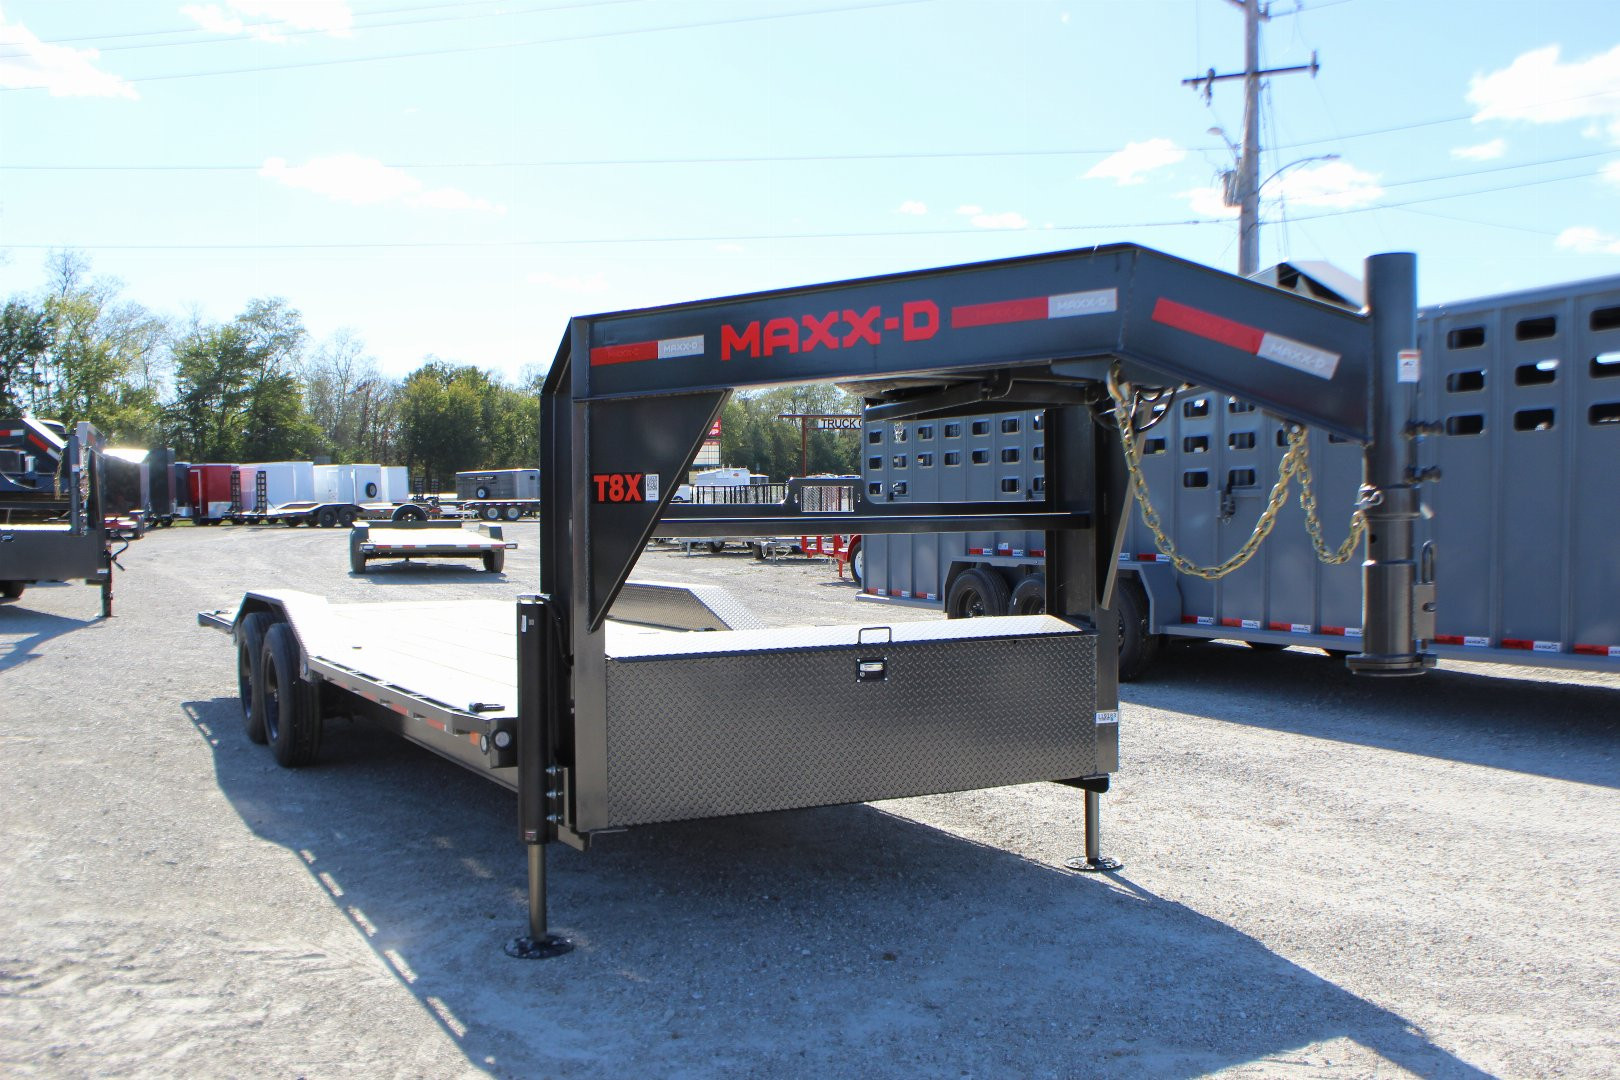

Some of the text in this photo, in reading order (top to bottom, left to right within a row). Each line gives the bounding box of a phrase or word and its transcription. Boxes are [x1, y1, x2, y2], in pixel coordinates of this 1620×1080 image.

[720, 300, 939, 361] MAXX-D
[663, 341, 698, 354] MAXX-D
[821, 418, 857, 429] TRUCK
[593, 473, 642, 502] T8X
